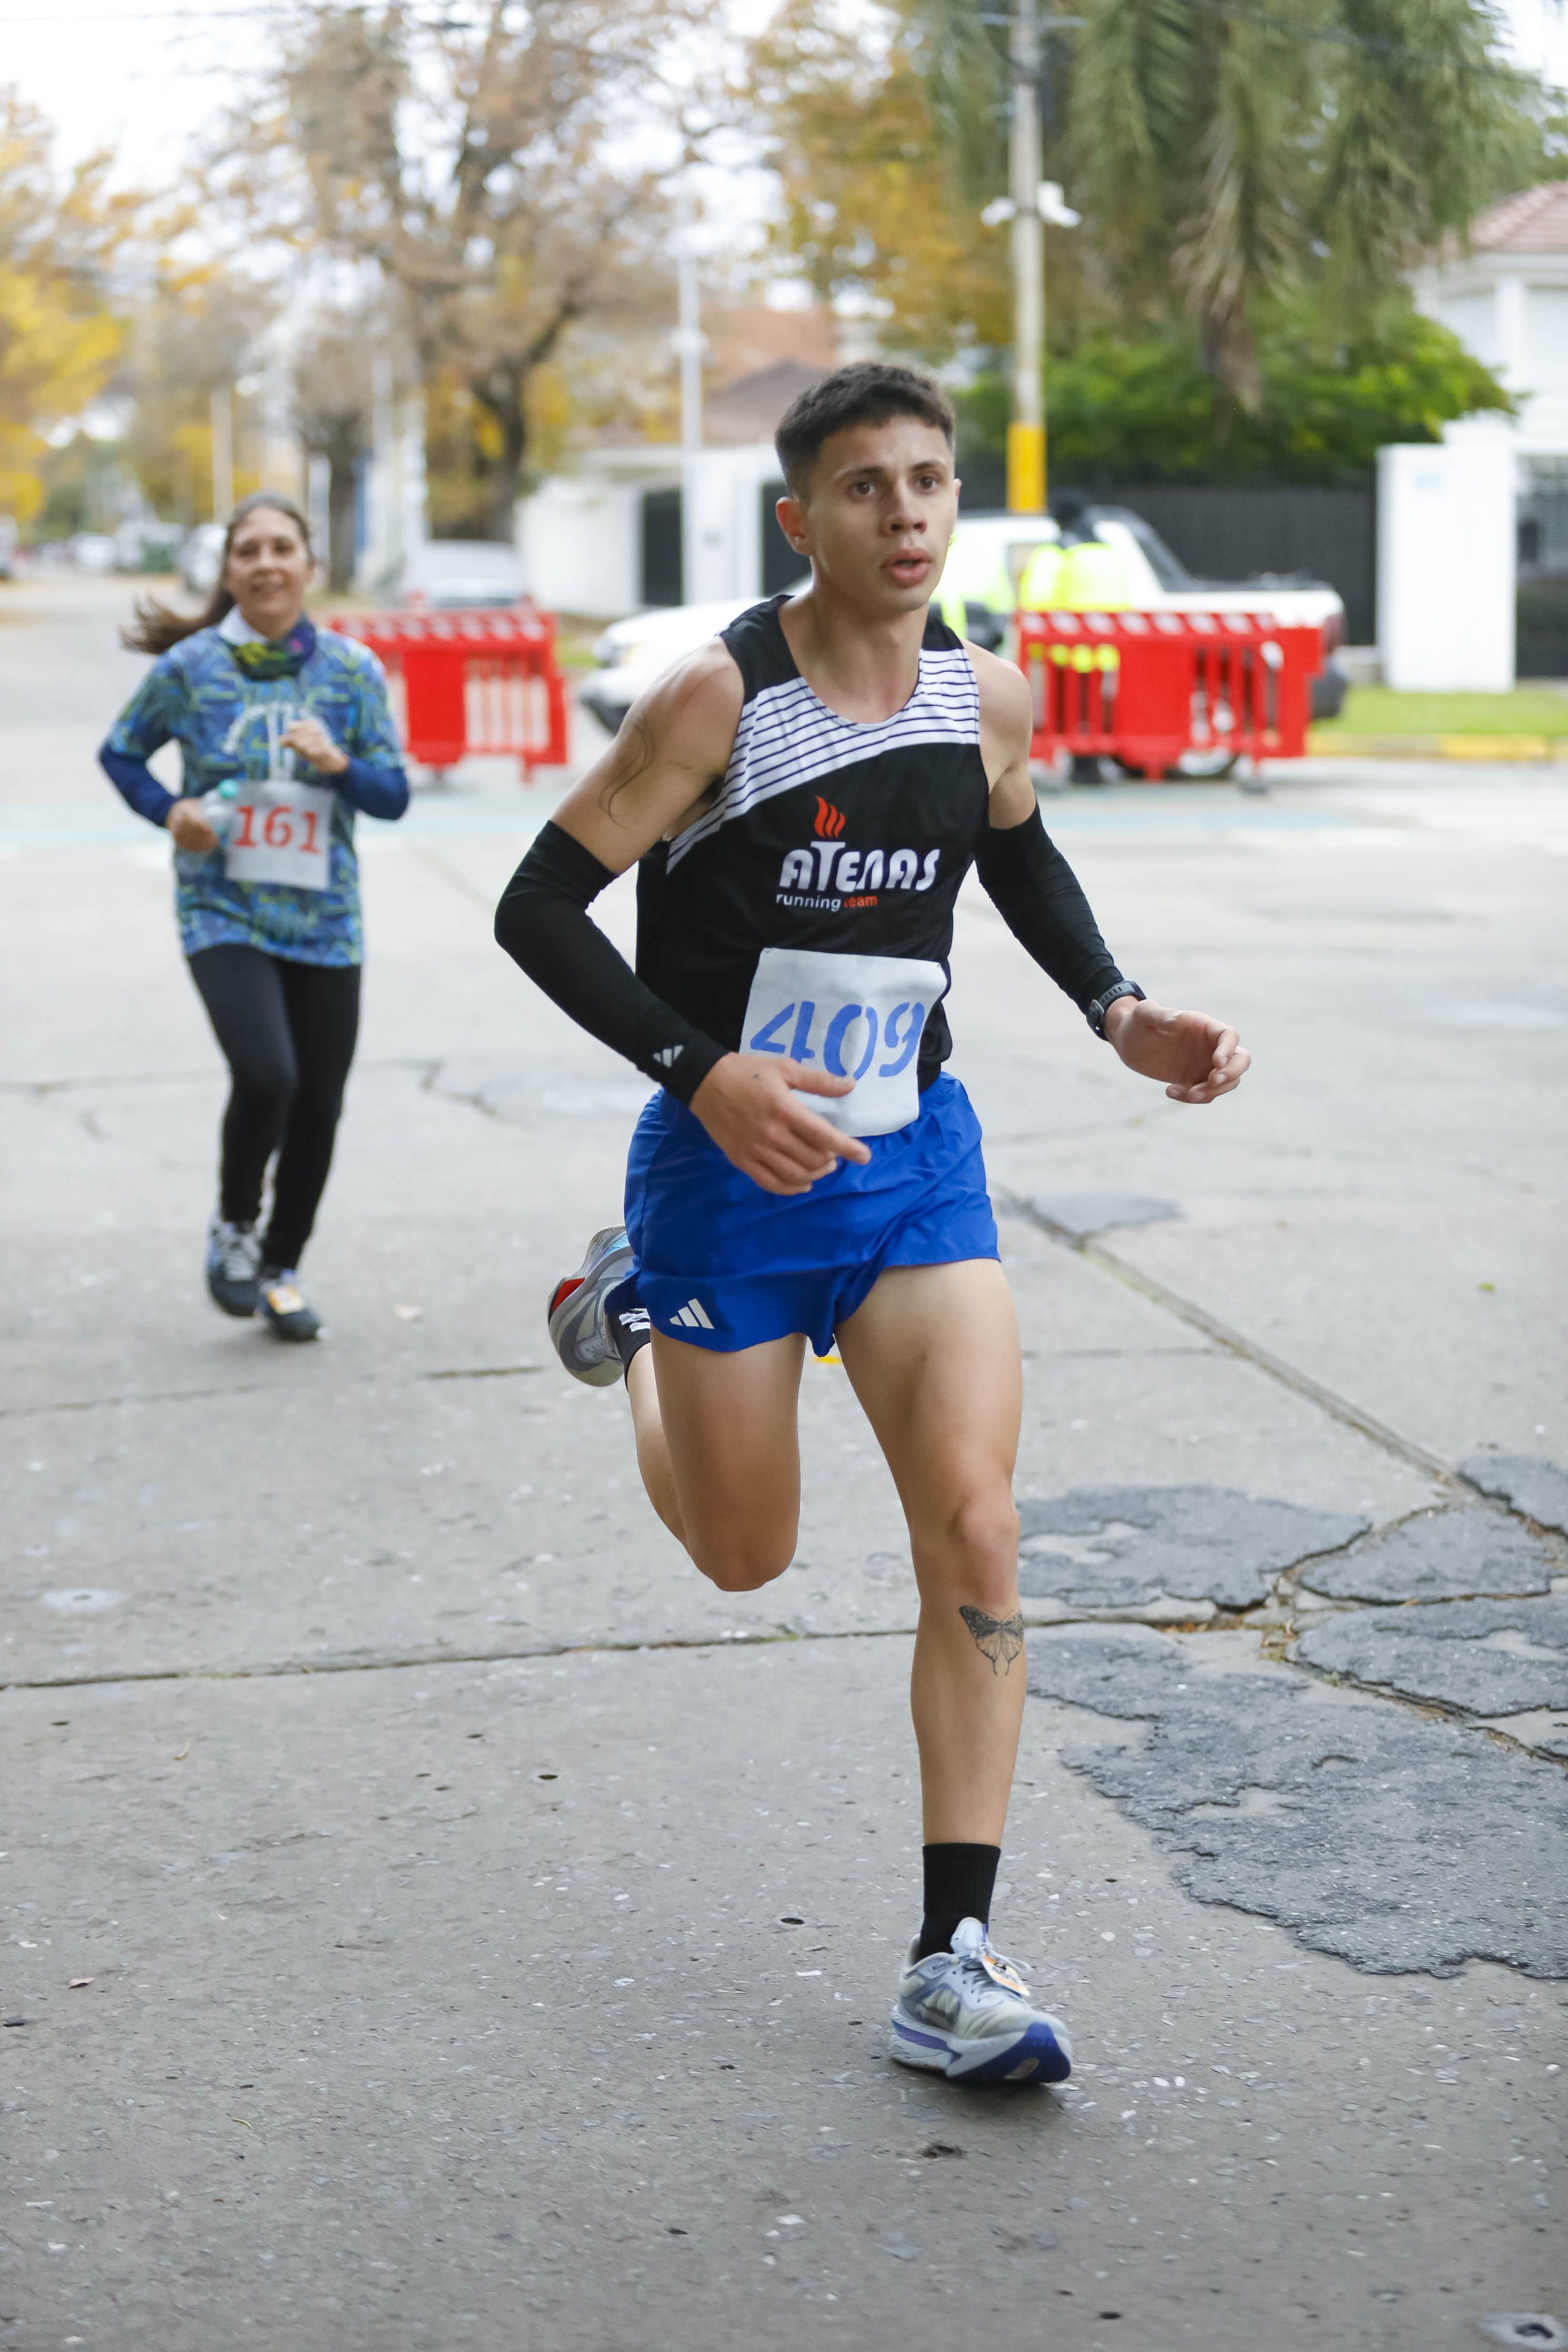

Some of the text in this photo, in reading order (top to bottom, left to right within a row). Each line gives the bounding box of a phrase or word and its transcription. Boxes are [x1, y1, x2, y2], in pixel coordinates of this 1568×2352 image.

[233, 805, 320, 854] 161
[779, 841, 940, 893] ATENAS
[776, 894, 841, 913] running
[750, 1001, 925, 1081] 409
